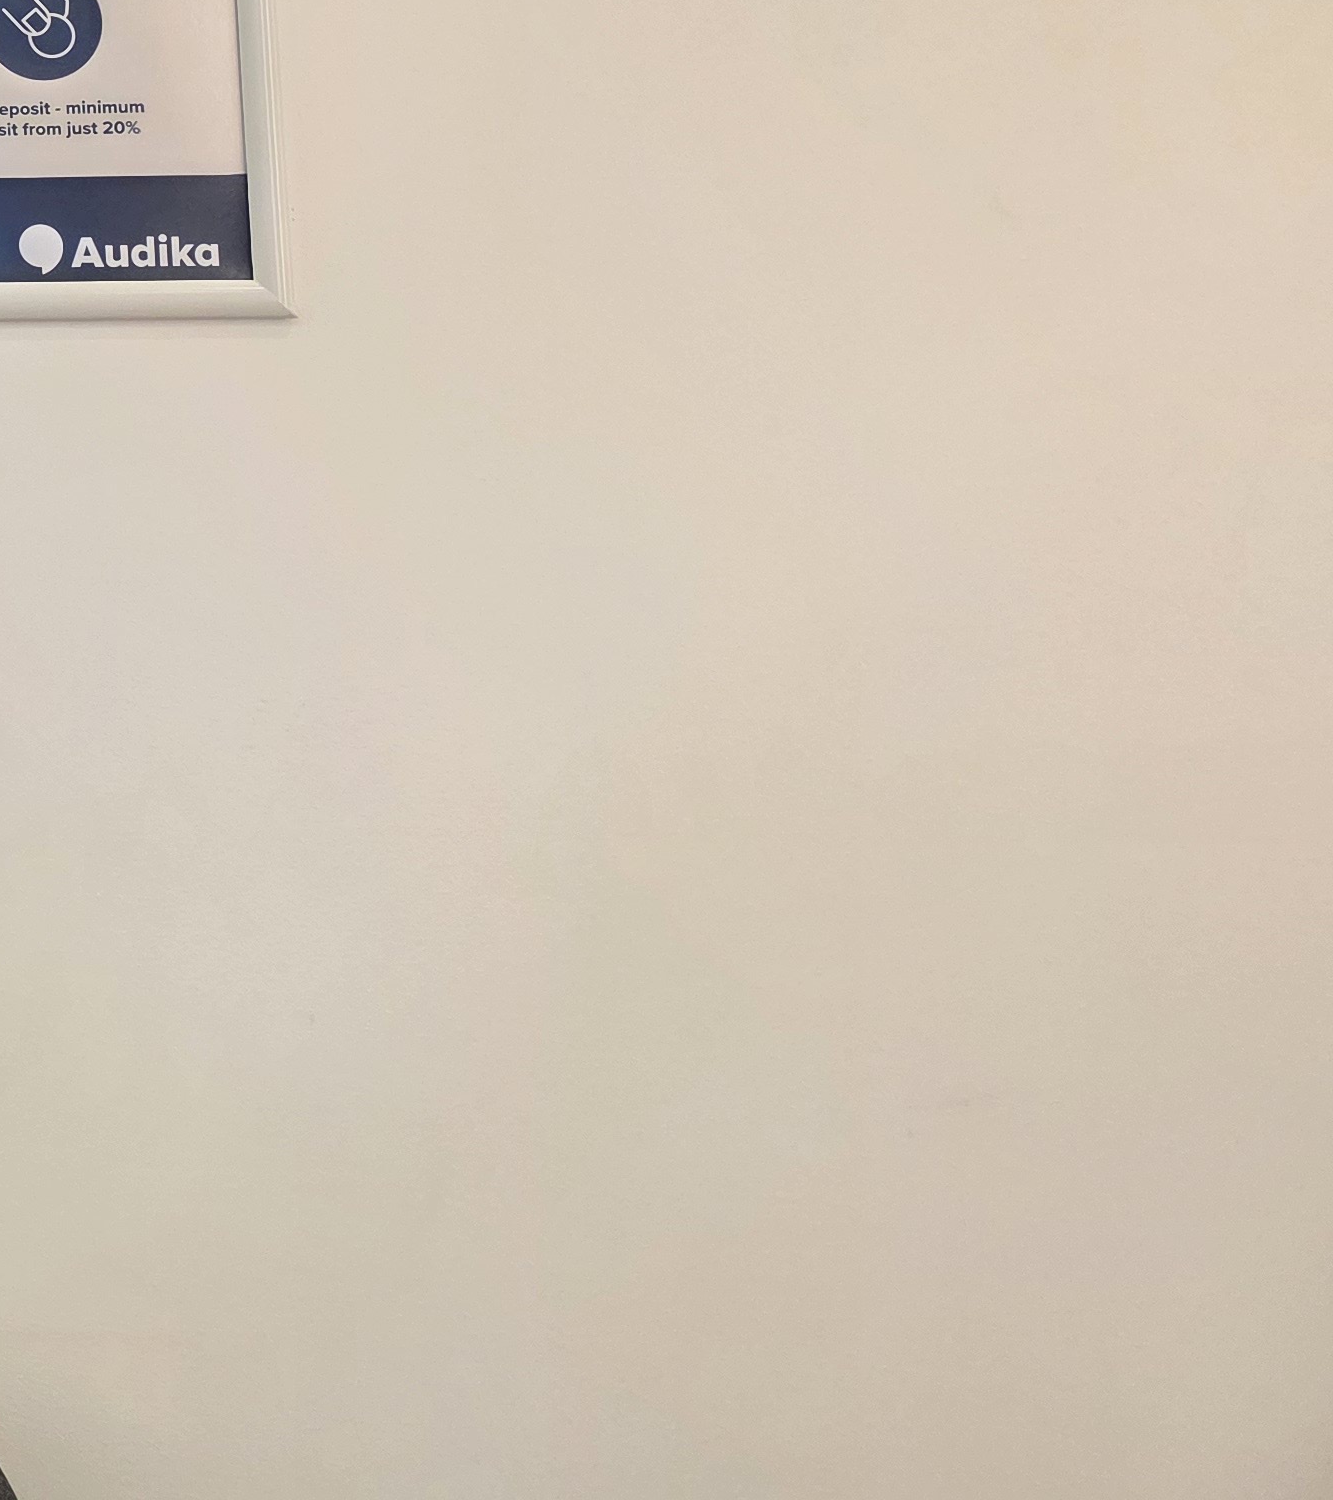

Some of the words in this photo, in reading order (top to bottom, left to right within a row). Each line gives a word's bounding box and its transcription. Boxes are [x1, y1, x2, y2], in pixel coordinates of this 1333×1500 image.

[66, 100, 145, 114] minimum
[22, 123, 61, 136] from
[66, 121, 98, 138] just
[103, 121, 141, 134] 20%
[71, 234, 220, 268] Audika
